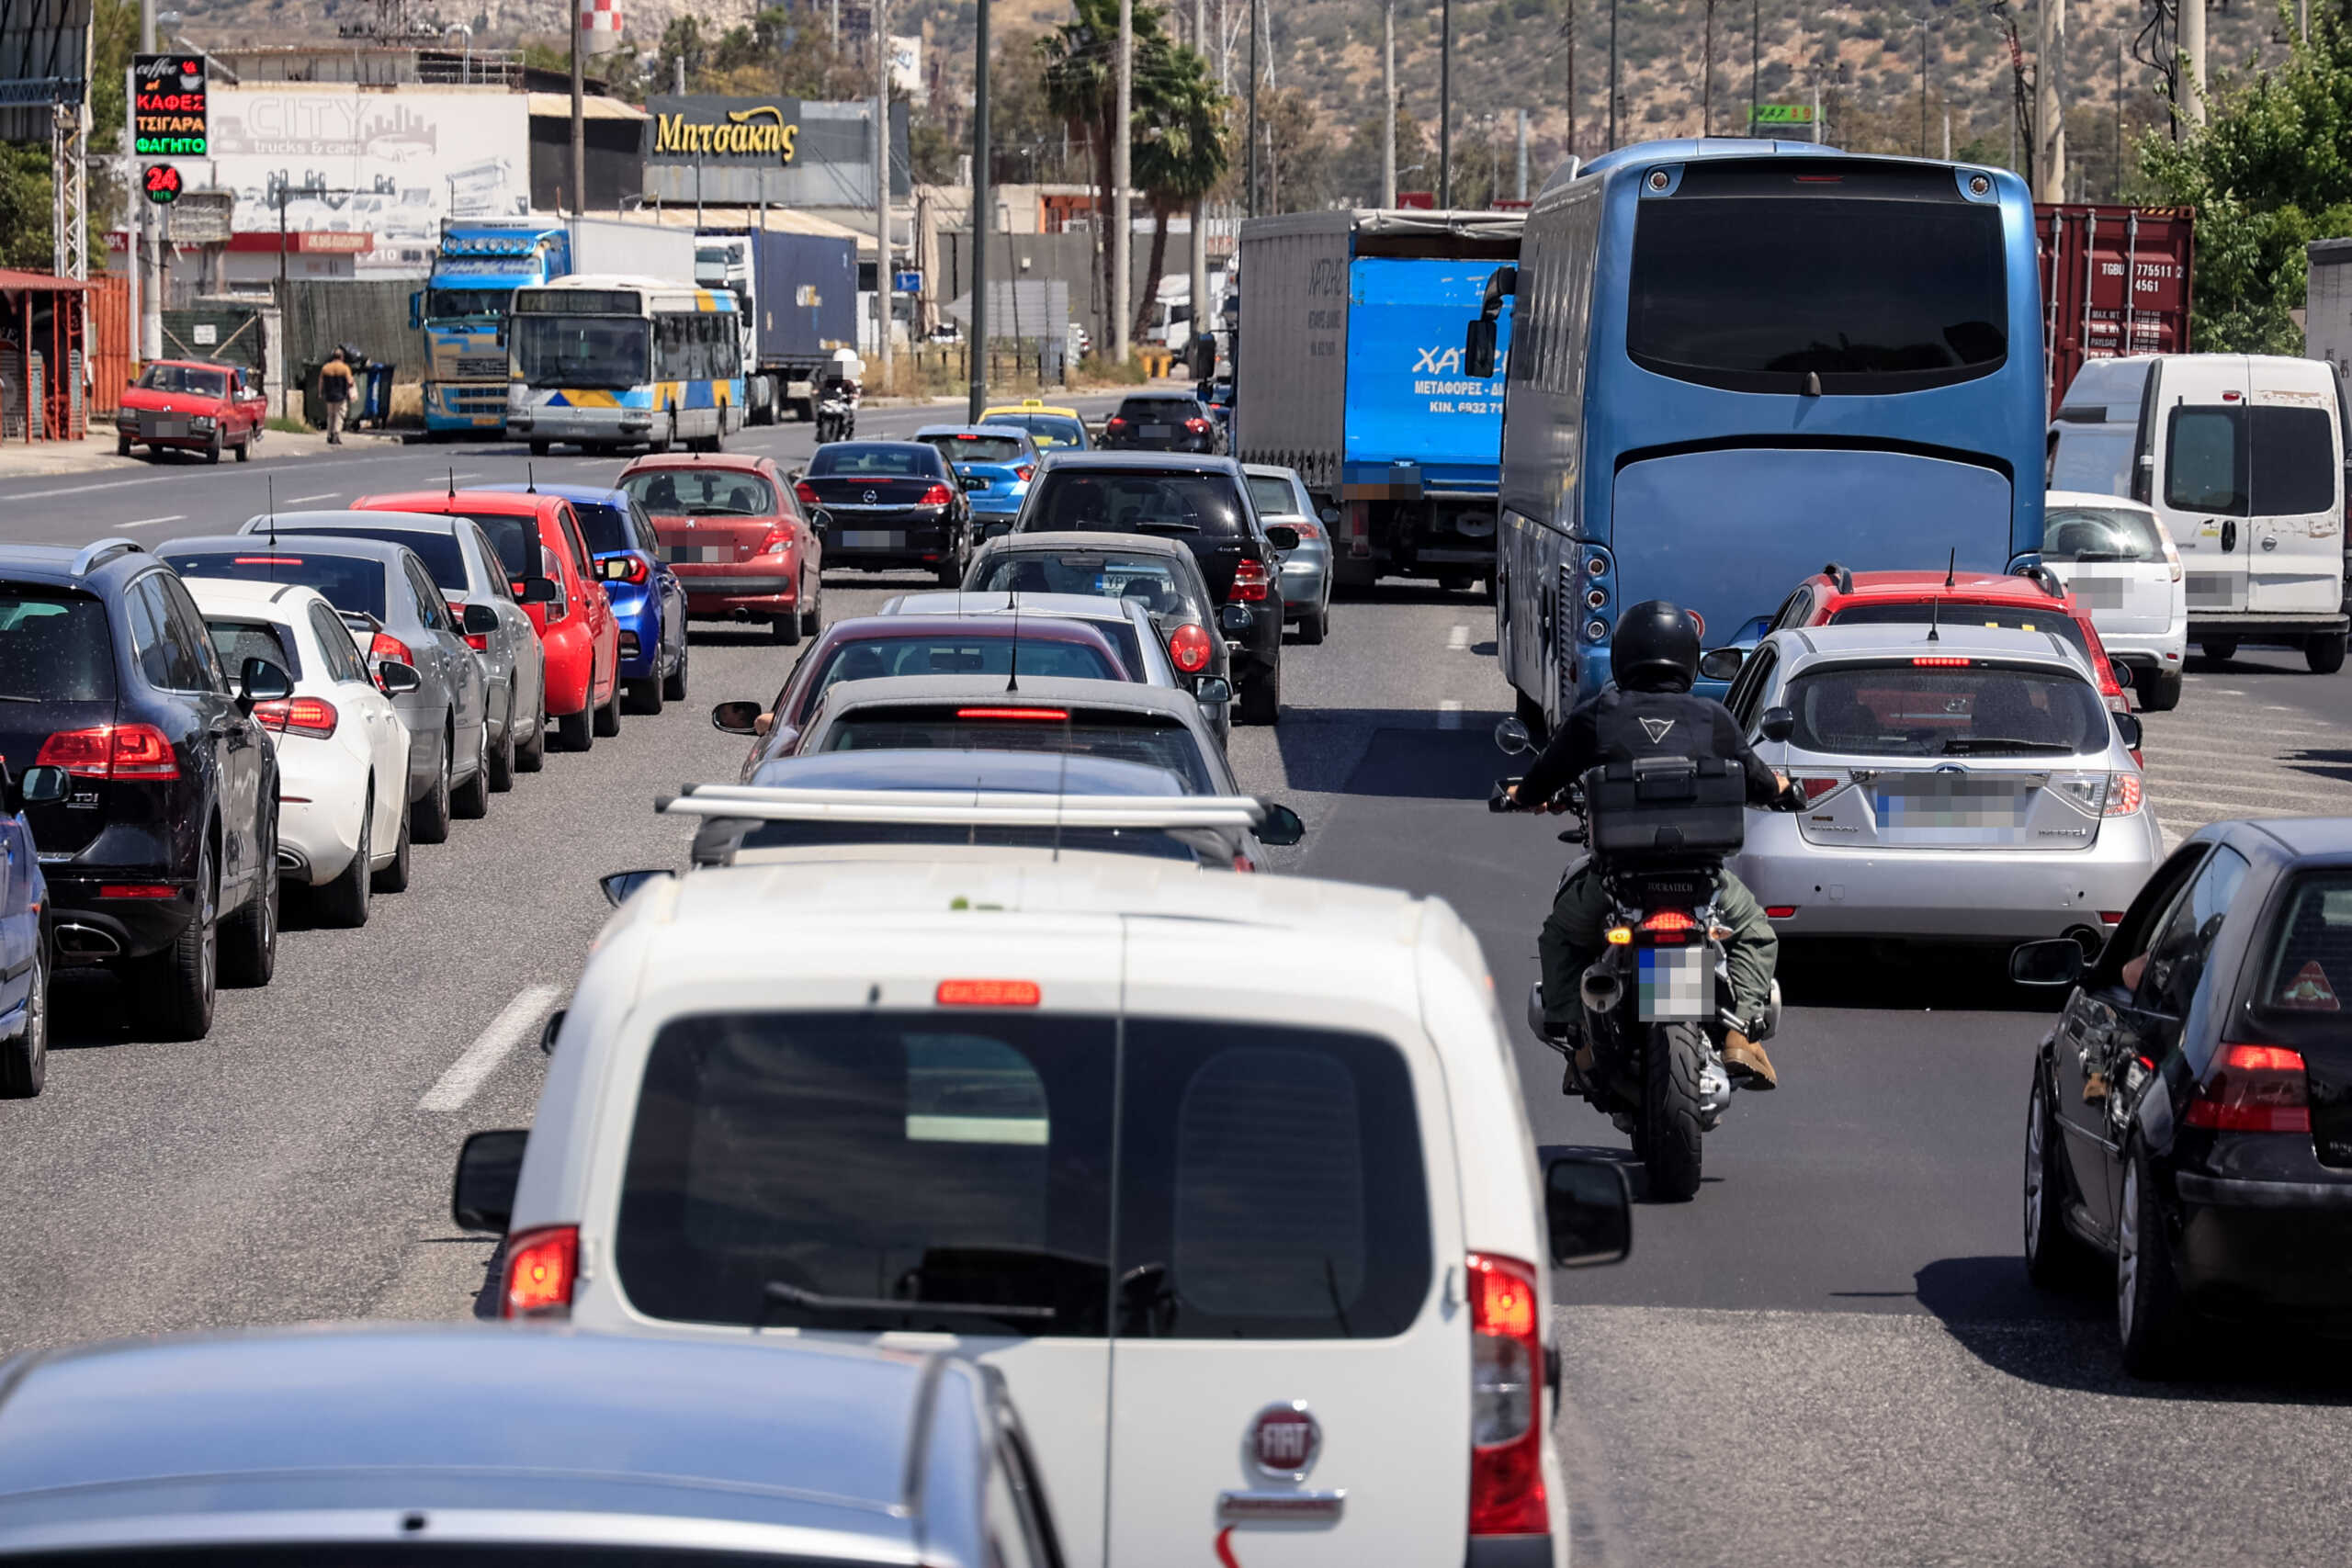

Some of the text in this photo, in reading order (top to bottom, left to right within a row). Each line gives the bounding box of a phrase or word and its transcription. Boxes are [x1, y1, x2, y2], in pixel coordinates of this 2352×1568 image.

[136, 57, 177, 79] coffee
[136, 94, 205, 111] ΚΑΦΕΣ
[136, 116, 206, 132] ΤΣΙΓΑΡΑ
[248, 96, 373, 139] CITY
[135, 137, 207, 154] ΦΑΓΗΤΟ
[254, 140, 363, 154] trucks & cars
[147, 166, 179, 191] 24
[2101, 263, 2125, 276] TGBU
[2136, 264, 2172, 277] 775511
[2134, 278, 2159, 292] 45G1
[1414, 380, 1483, 395] ΜΕΤΑΦΟΡΕΣ
[1430, 401, 1455, 413] ΚΙΝ.
[74, 793, 99, 803] TDI
[1262, 1423, 1308, 1458] FIAT
